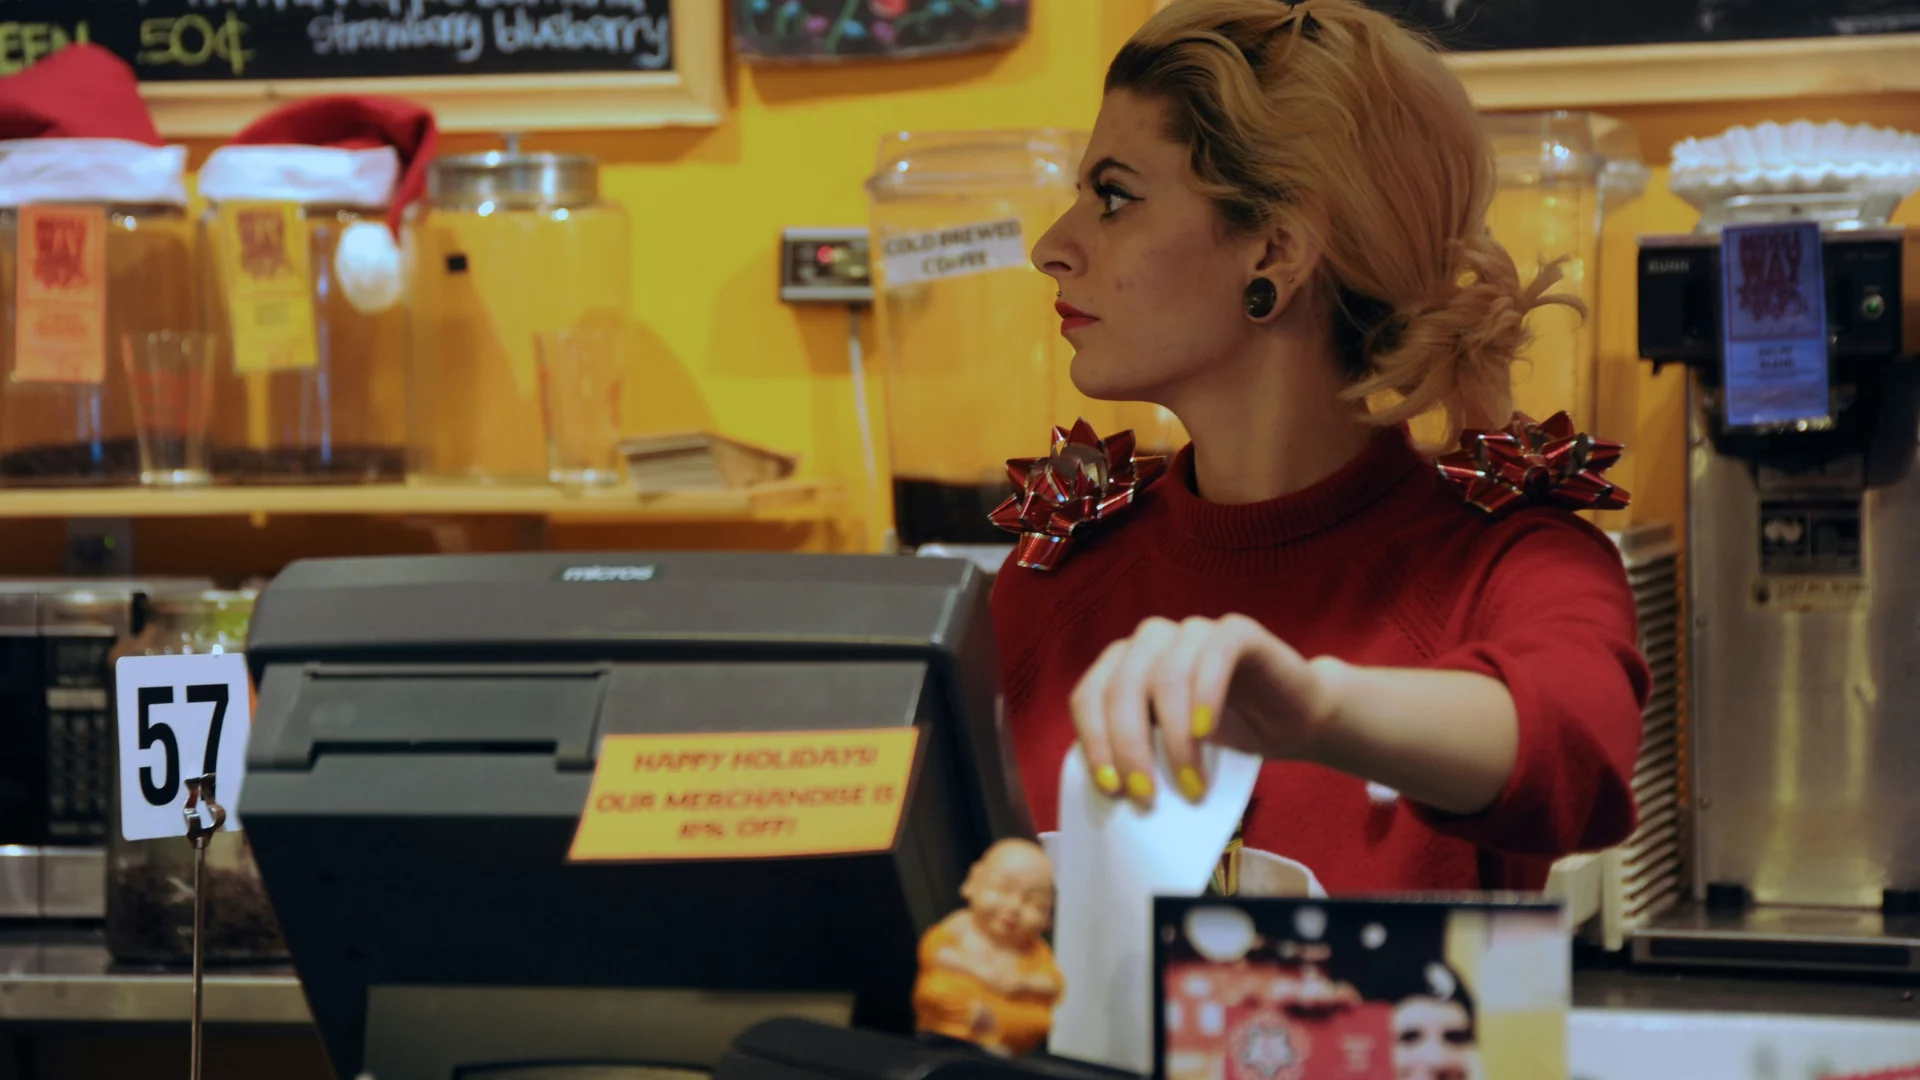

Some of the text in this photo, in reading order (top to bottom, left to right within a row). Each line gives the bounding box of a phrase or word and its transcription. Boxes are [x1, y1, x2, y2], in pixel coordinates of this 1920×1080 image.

[884, 218, 1022, 256] COLD BREWED
[922, 249, 987, 273] COFFEE
[562, 565, 654, 582] micros
[137, 684, 229, 806] 57
[634, 750, 727, 773] HAPPY
[596, 785, 896, 813] OUR MERCHANDISE IS
